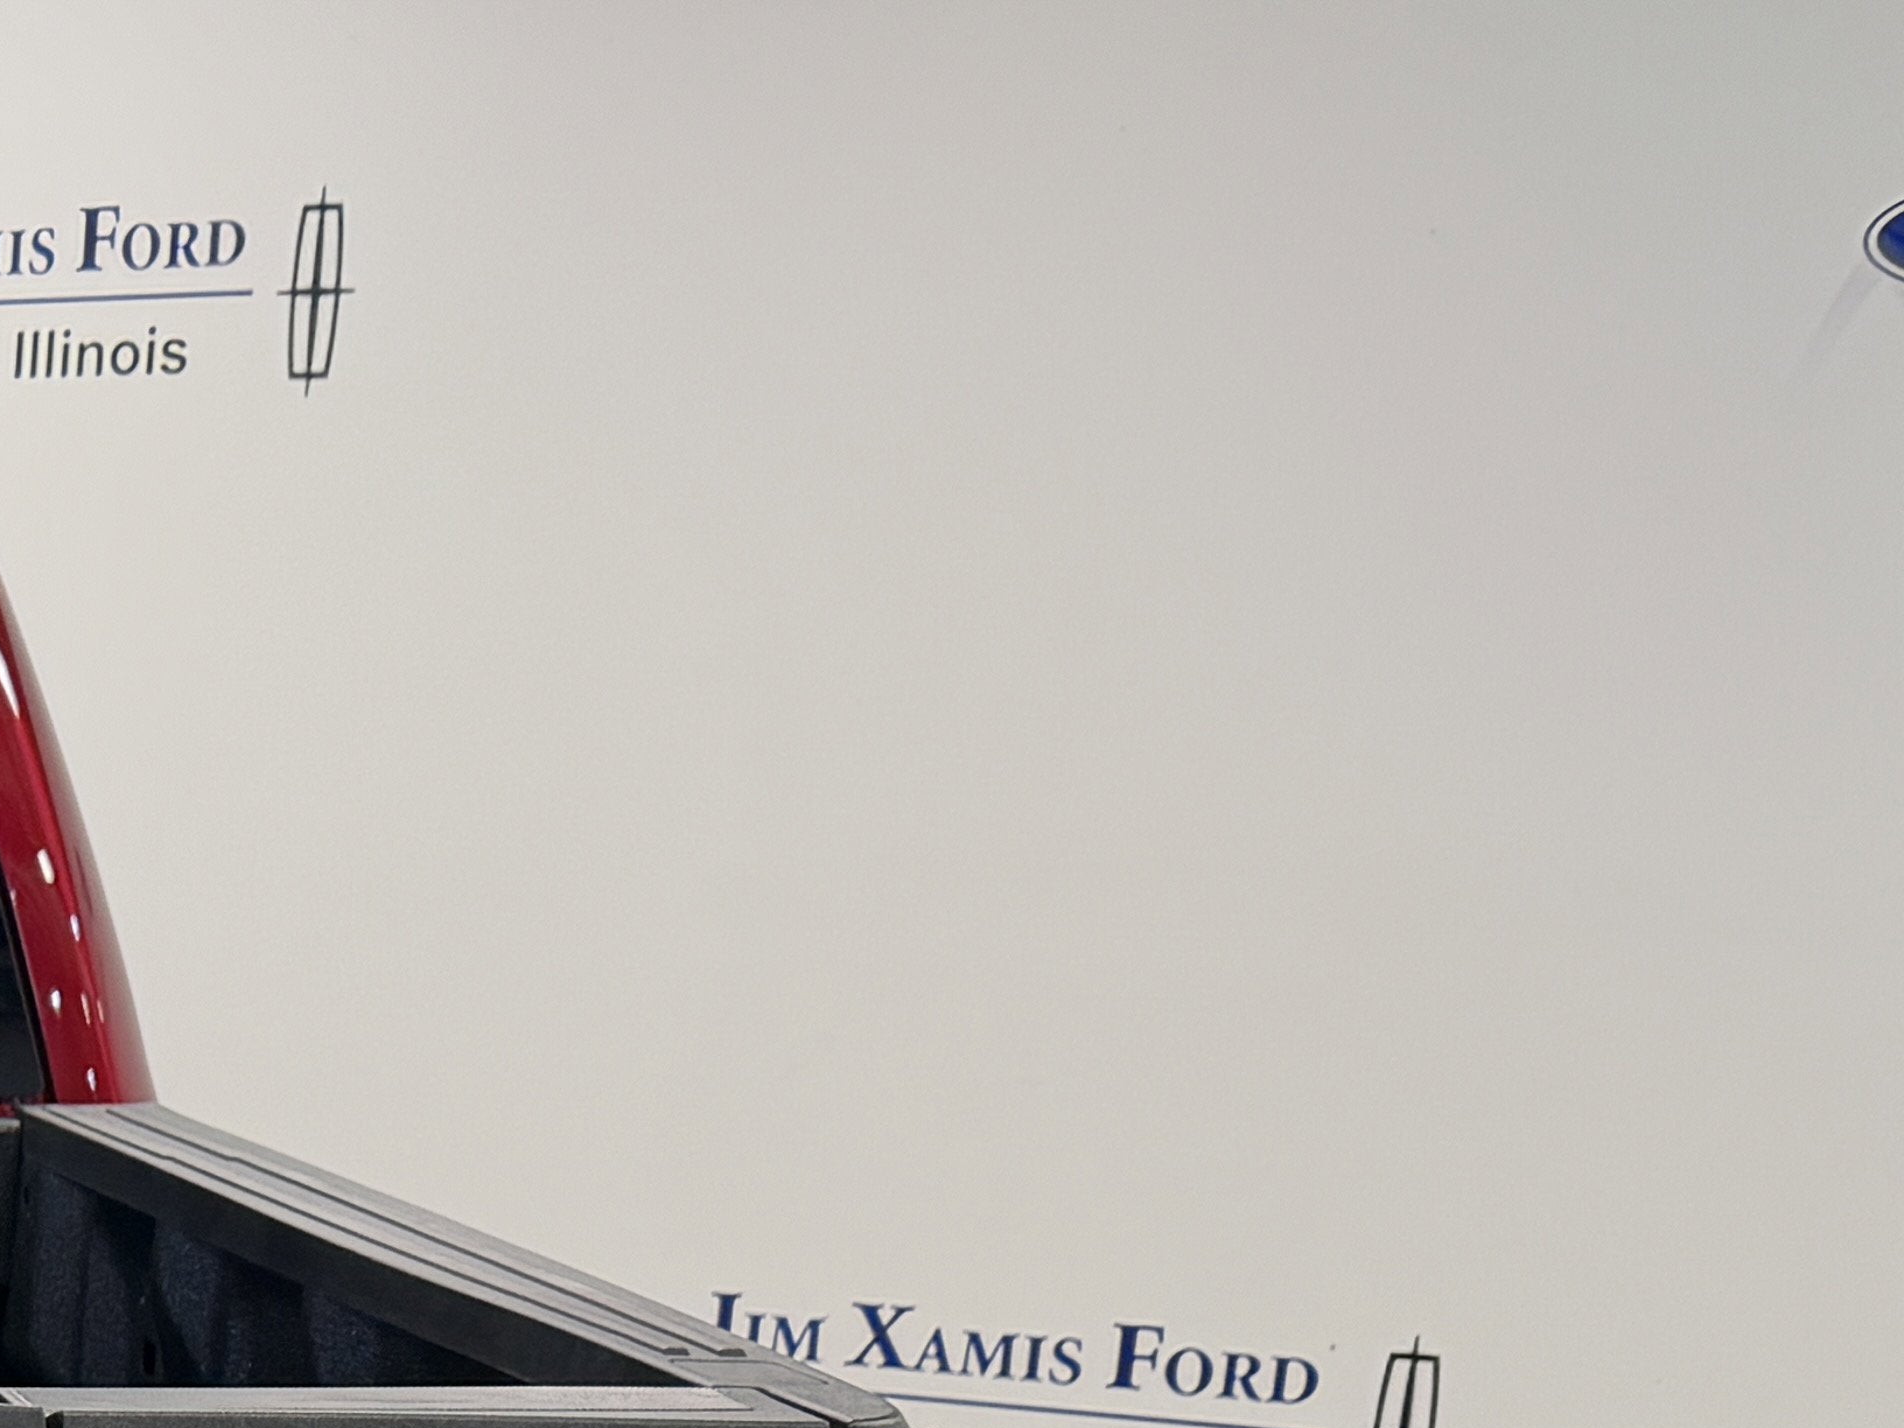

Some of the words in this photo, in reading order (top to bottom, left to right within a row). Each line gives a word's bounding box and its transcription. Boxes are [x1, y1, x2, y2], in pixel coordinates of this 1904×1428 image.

[76, 205, 246, 272] FORD
[14, 327, 187, 375] Illinois
[844, 1301, 1082, 1386] XAMIS
[1106, 1323, 1319, 1404] FORD
